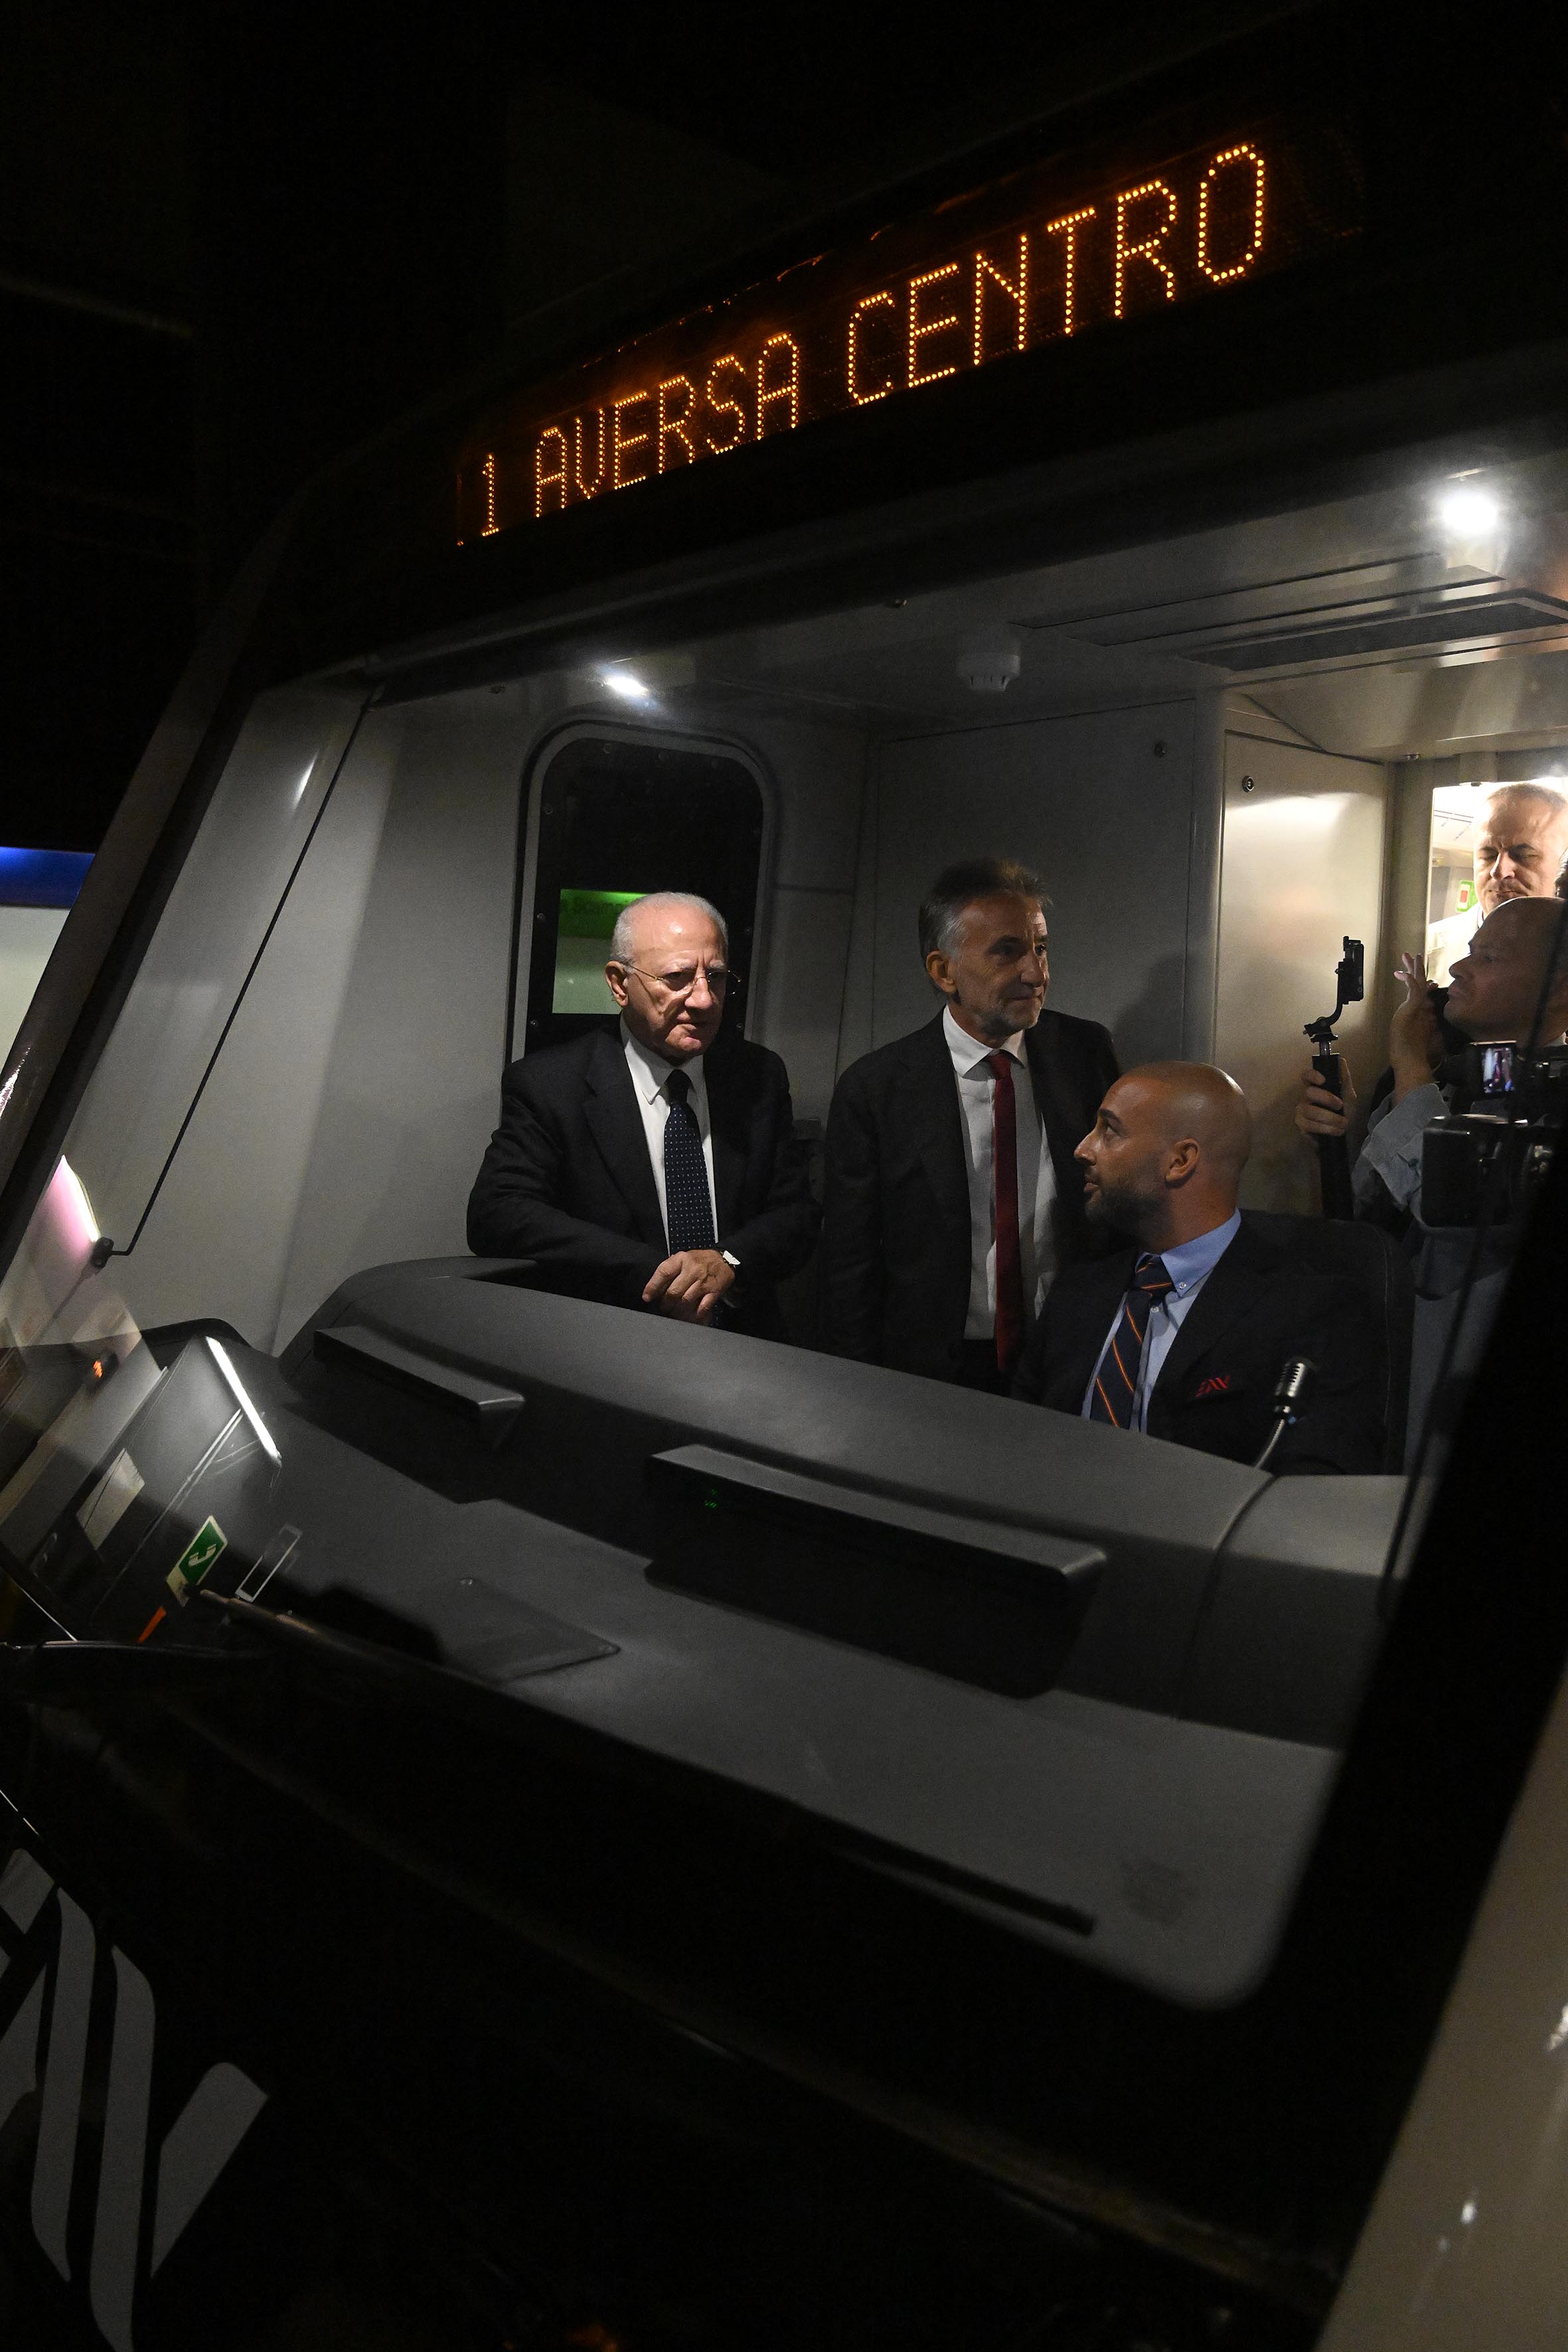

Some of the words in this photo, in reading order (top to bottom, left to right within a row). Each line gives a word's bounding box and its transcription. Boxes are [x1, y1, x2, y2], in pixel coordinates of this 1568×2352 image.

[481, 453, 500, 537] 1
[534, 331, 801, 518] AVERSA
[847, 143, 1265, 406] CENTRO
